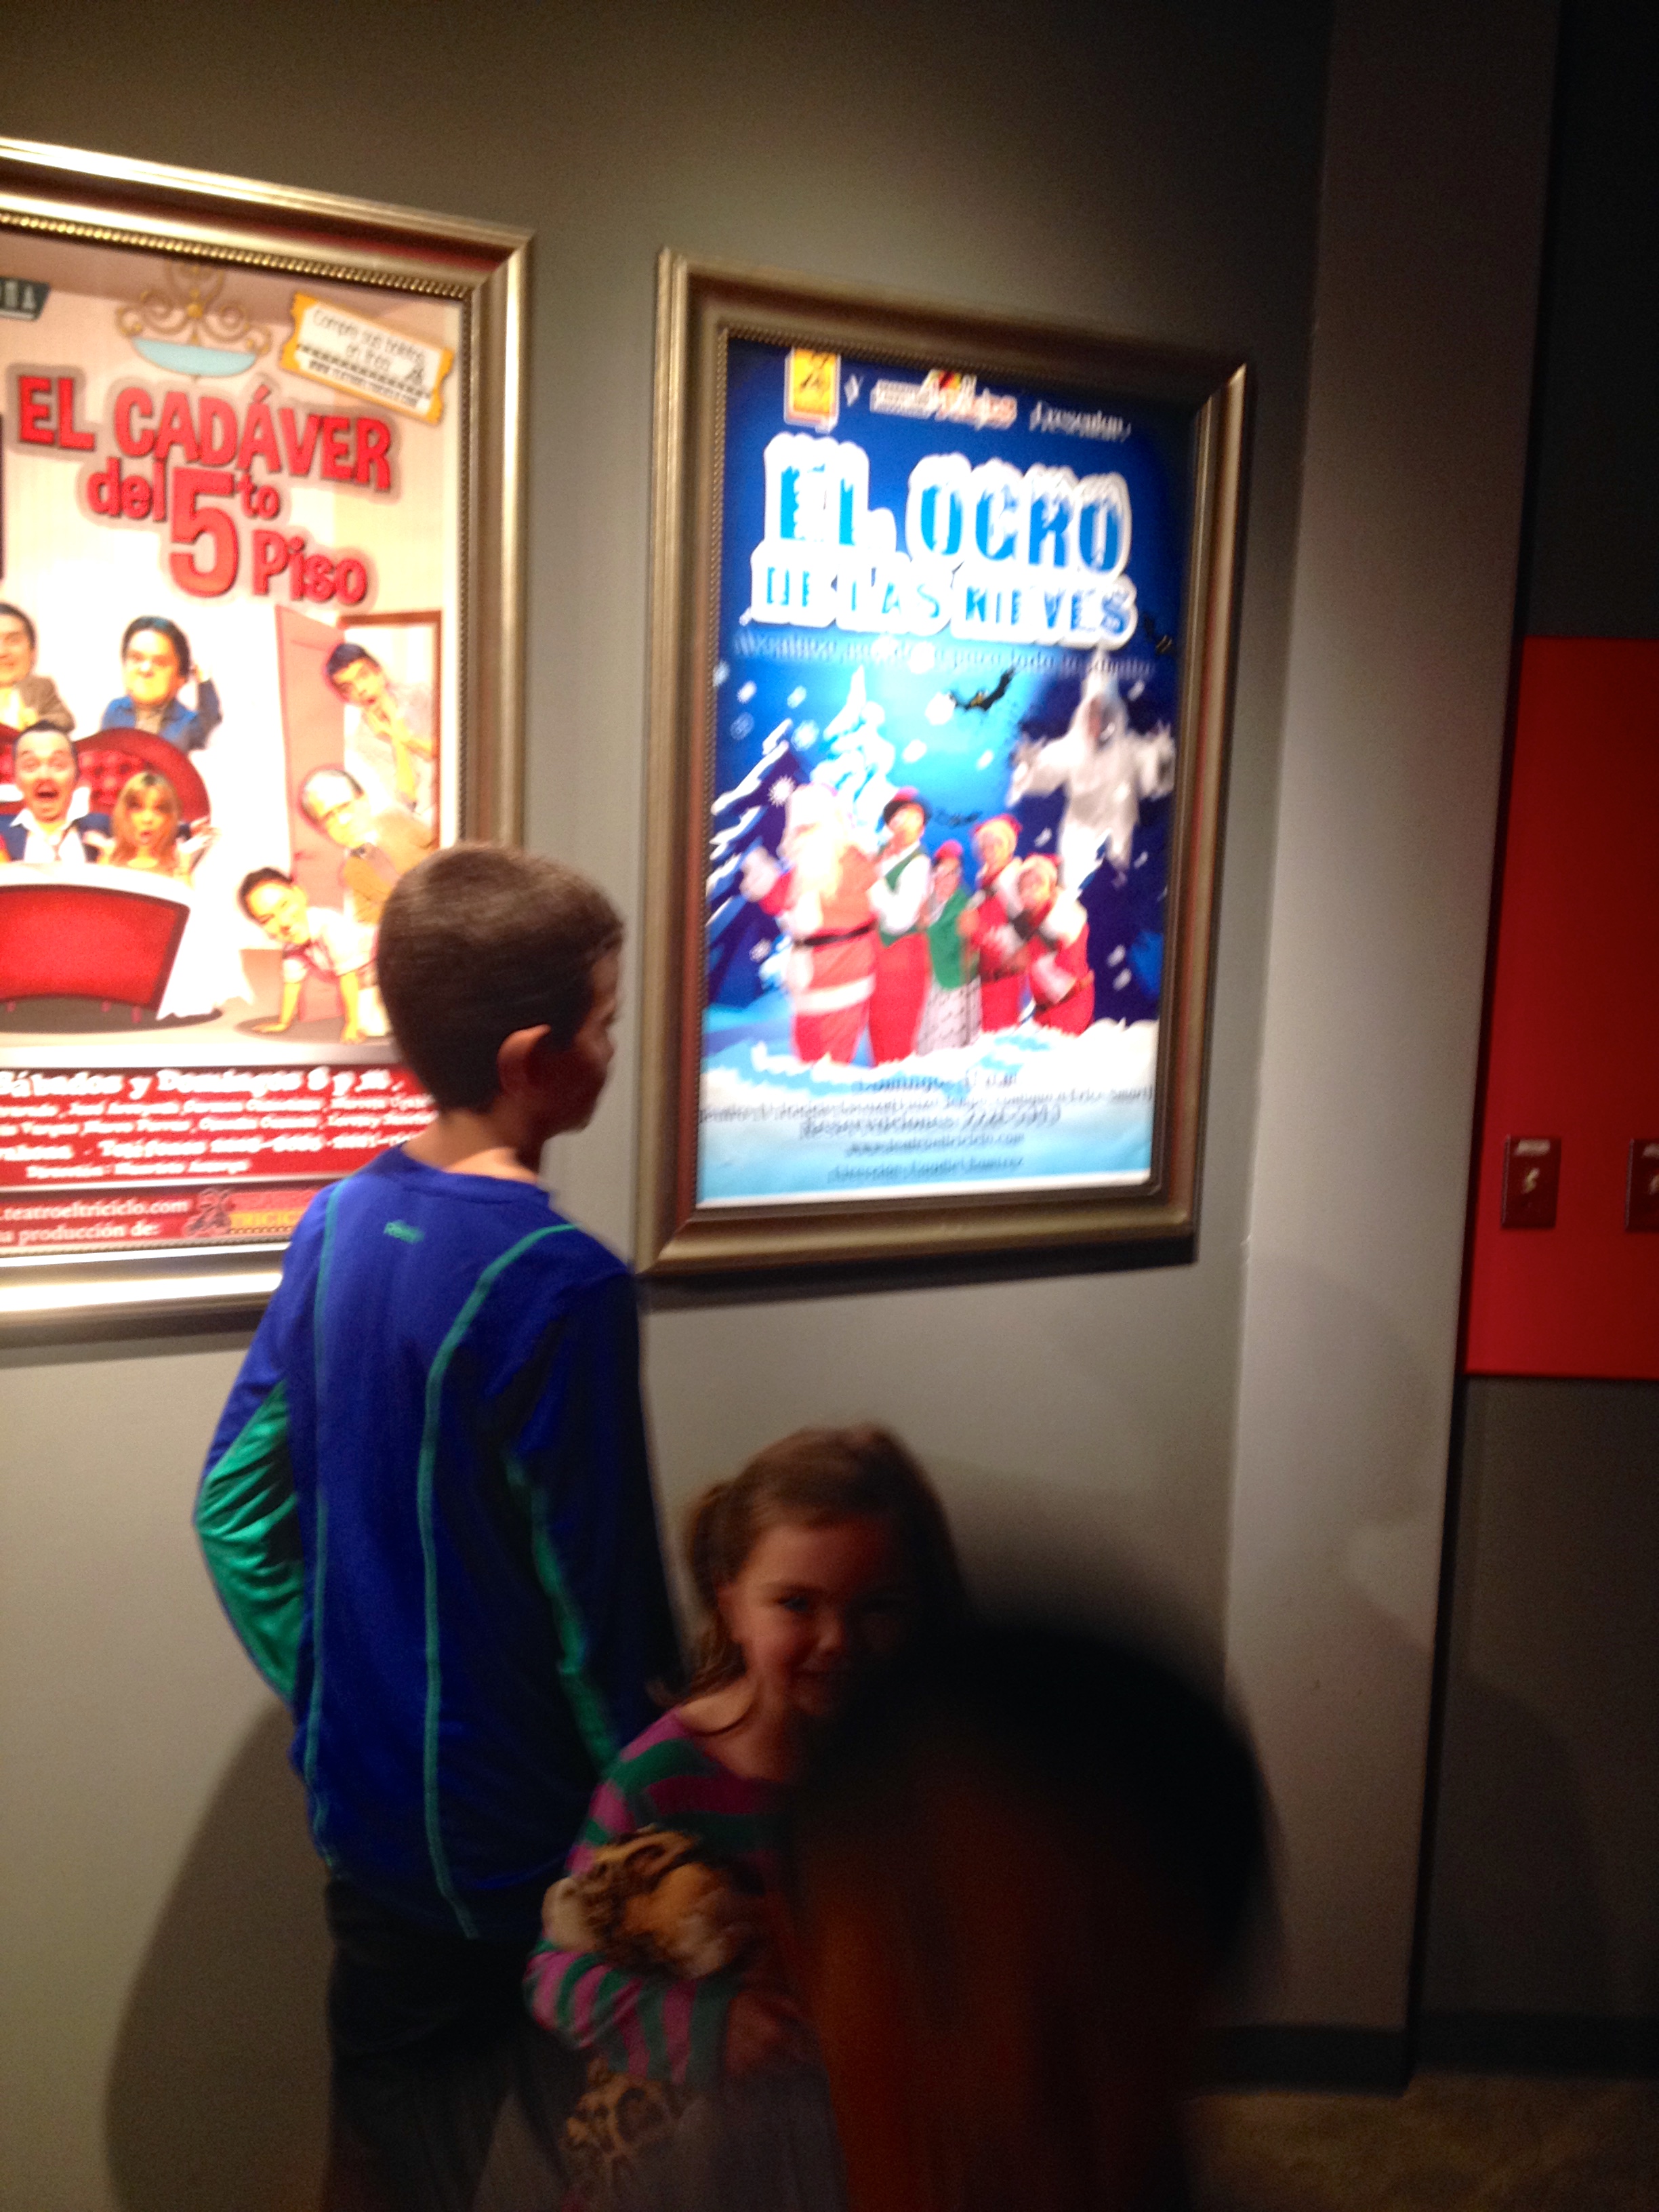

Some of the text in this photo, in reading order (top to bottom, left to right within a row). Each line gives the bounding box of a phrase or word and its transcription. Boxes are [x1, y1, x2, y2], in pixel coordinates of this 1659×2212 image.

[18, 375, 96, 451] EL
[113, 384, 393, 491] CADÁVER
[86, 457, 167, 522] del
[251, 529, 368, 606] Piso
